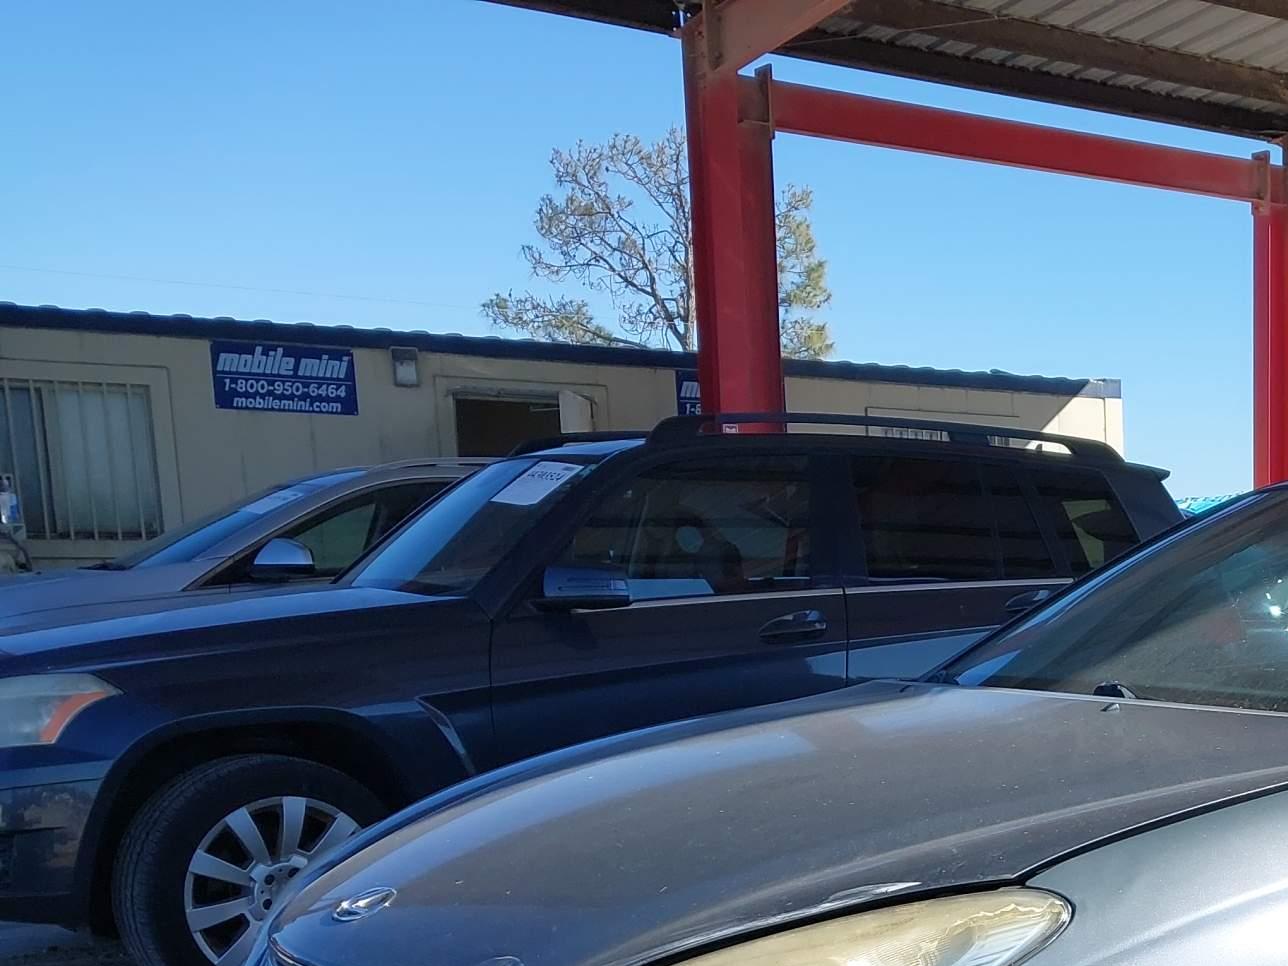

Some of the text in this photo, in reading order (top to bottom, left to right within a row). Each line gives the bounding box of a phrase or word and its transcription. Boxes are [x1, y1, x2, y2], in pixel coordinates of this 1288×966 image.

[216, 346, 349, 378] mobile mini
[224, 379, 347, 398] 1-800-950-6464
[232, 396, 342, 413] mobilemini.com
